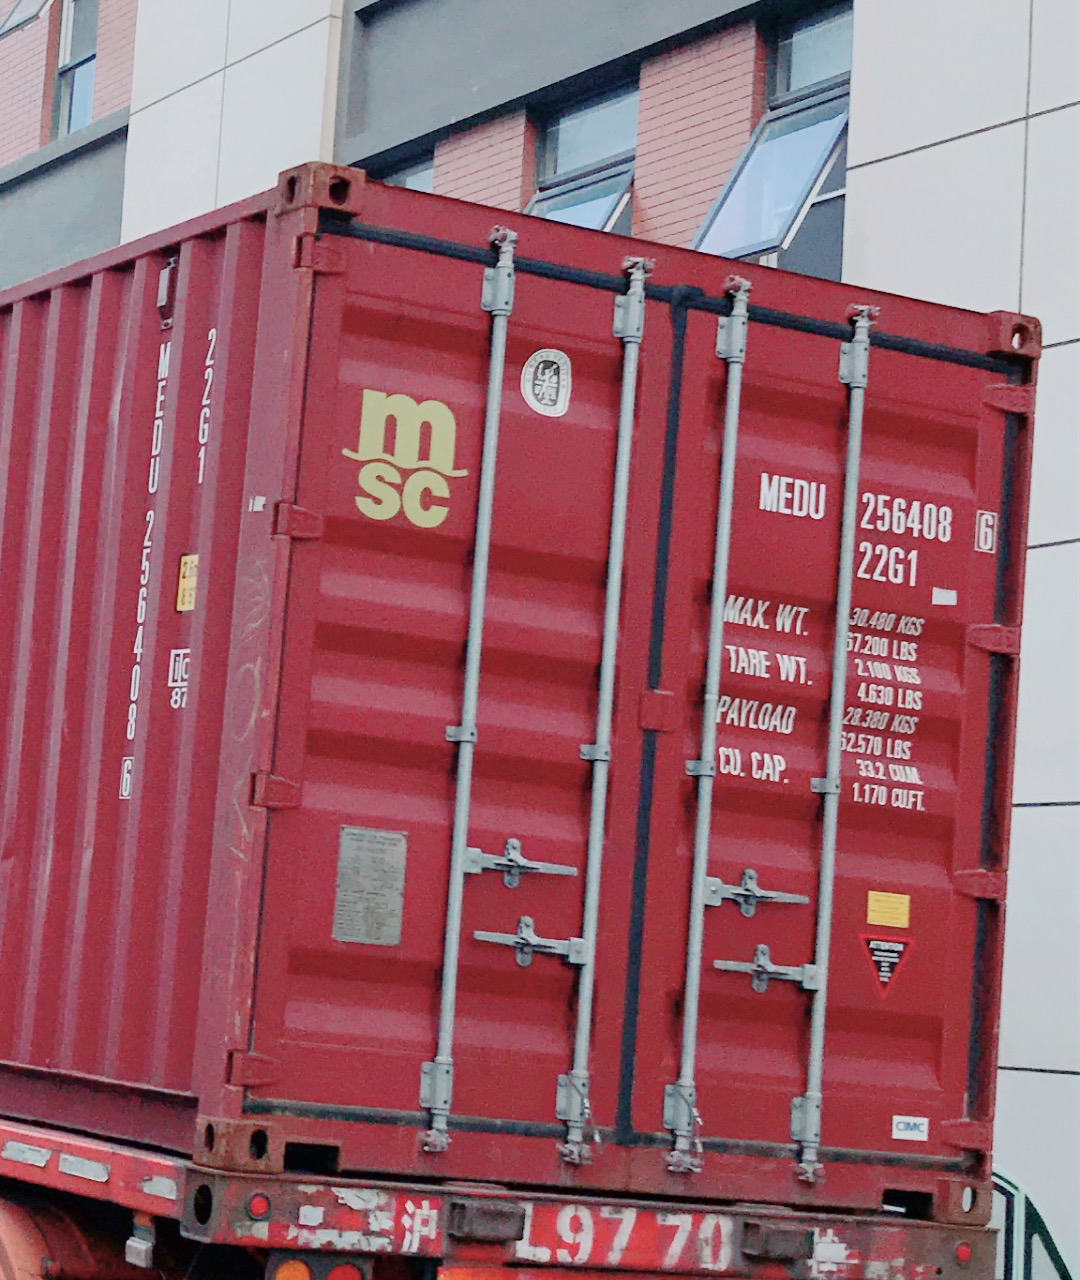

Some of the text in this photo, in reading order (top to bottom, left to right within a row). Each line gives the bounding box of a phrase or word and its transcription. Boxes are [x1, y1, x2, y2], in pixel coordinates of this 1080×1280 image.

[148, 341, 172, 494] MEDU
[197, 327, 217, 484] 22G1
[758, 472, 996, 553] MEDU 256408 6
[856, 541, 919, 588] 22G1
[126, 509, 155, 741] 256408
[722, 594, 810, 637] MAX. WT.
[897, 615, 926, 637] KGS
[724, 644, 813, 686] TARE WT.
[892, 640, 919, 662] LBS
[893, 664, 921, 686] KGS
[716, 695, 797, 735] PAYLOAD
[857, 681, 924, 711] 4.630 LBS
[842, 706, 919, 735] 28.380 KGS
[718, 746, 790, 784] CU. CAP.
[886, 738, 912, 761] LBS
[852, 781, 888, 806] 1.170
[400, 1199, 438, 1253] 沪
